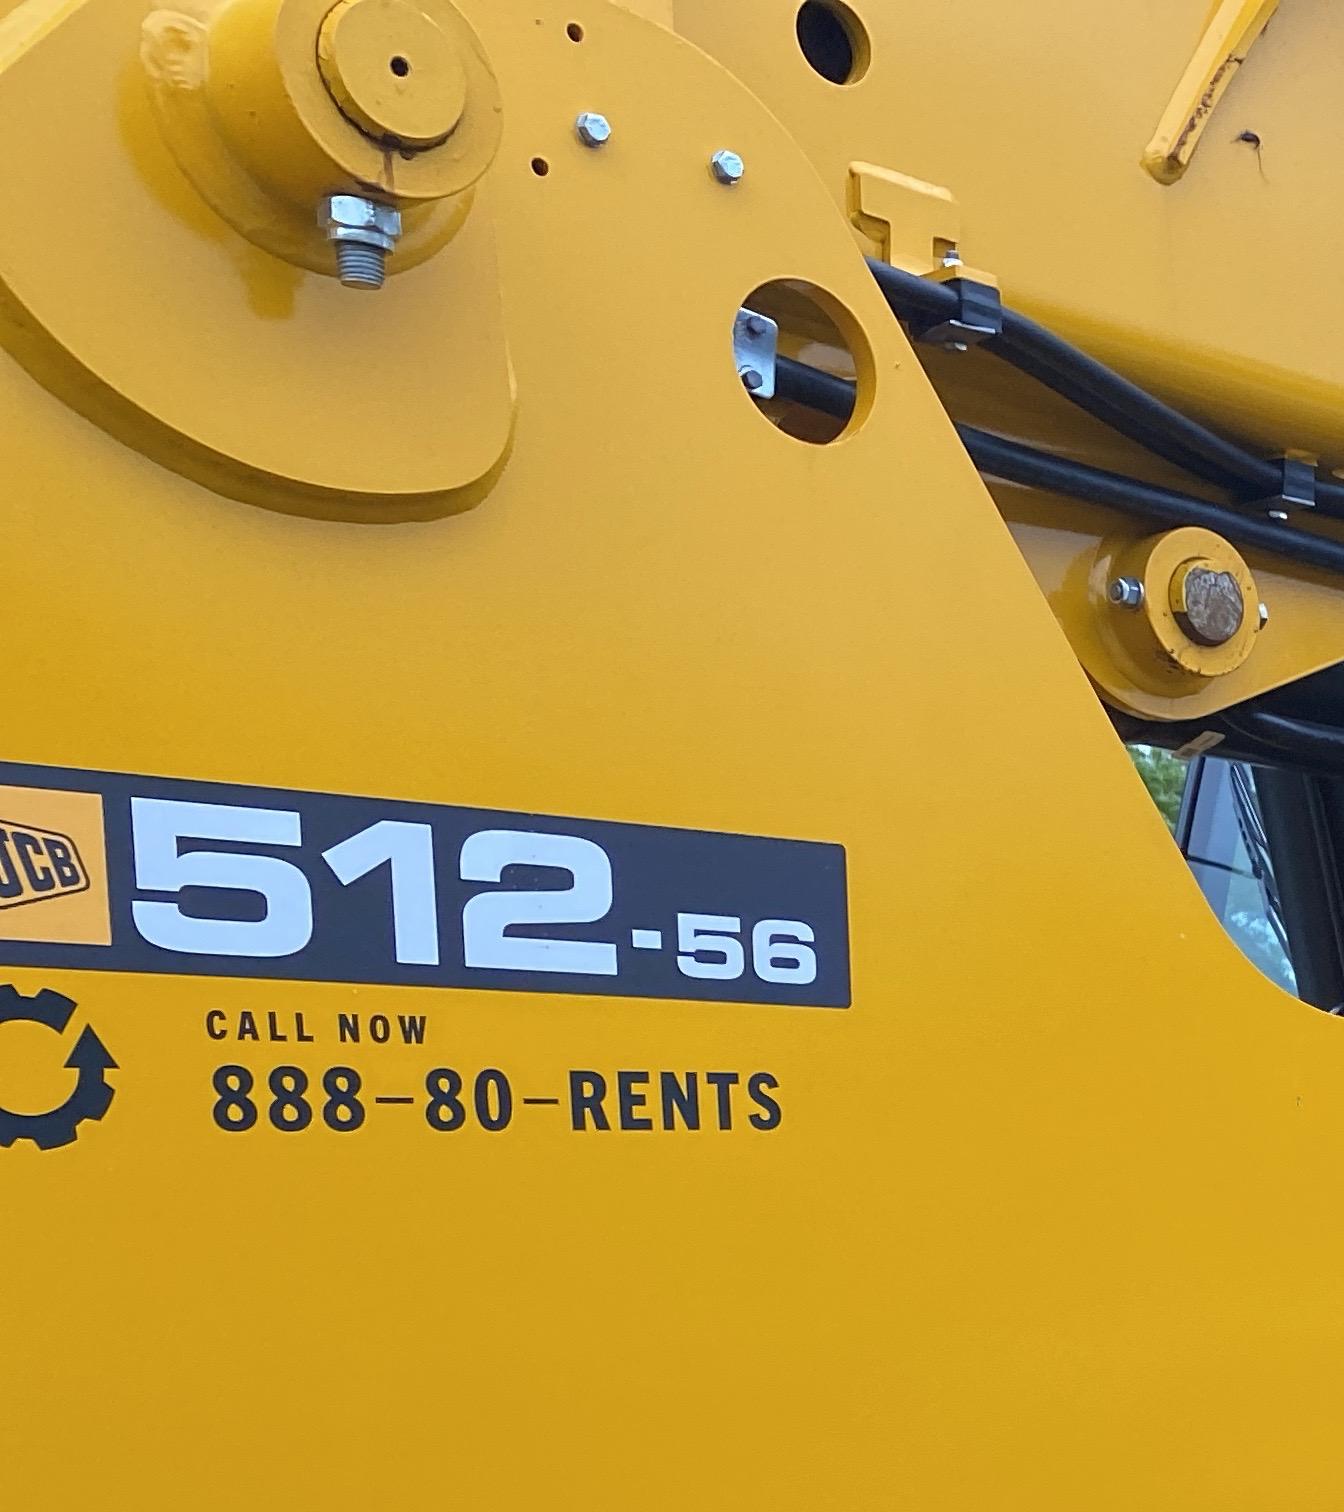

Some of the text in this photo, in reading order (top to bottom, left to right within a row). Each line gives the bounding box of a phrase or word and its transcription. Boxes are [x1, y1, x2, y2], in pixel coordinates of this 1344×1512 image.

[0, 827, 80, 899] JCB
[130, 796, 818, 985] 512-56
[206, 1010, 429, 1045] CALL NOW
[212, 1063, 783, 1132] 888-80-RENTS
